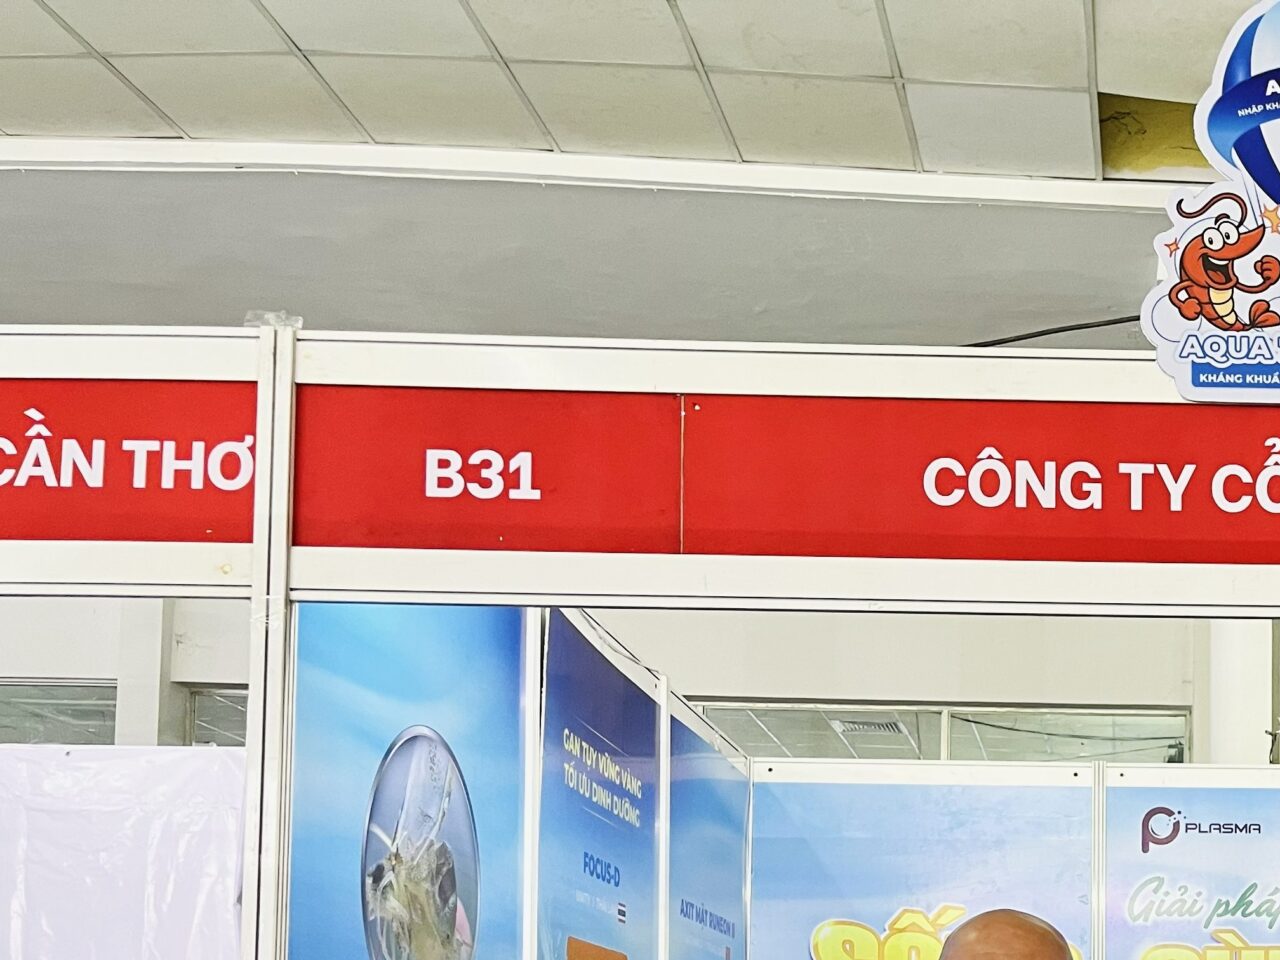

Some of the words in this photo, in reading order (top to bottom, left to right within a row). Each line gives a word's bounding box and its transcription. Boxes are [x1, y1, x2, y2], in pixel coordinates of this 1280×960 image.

[1179, 335, 1273, 362] AQUA
[1200, 373, 1243, 384] KHÁNG
[122, 435, 255, 491] THƠ
[425, 449, 541, 500] B31
[924, 447, 1102, 510] CÔNG
[1119, 462, 1197, 511] TY
[563, 727, 580, 758] GAN
[621, 767, 642, 799] VÀNG
[591, 781, 612, 812] DINH
[1185, 823, 1262, 834] PLASMA
[583, 851, 621, 888] FOCUS-D
[1127, 876, 1204, 922] Giải
